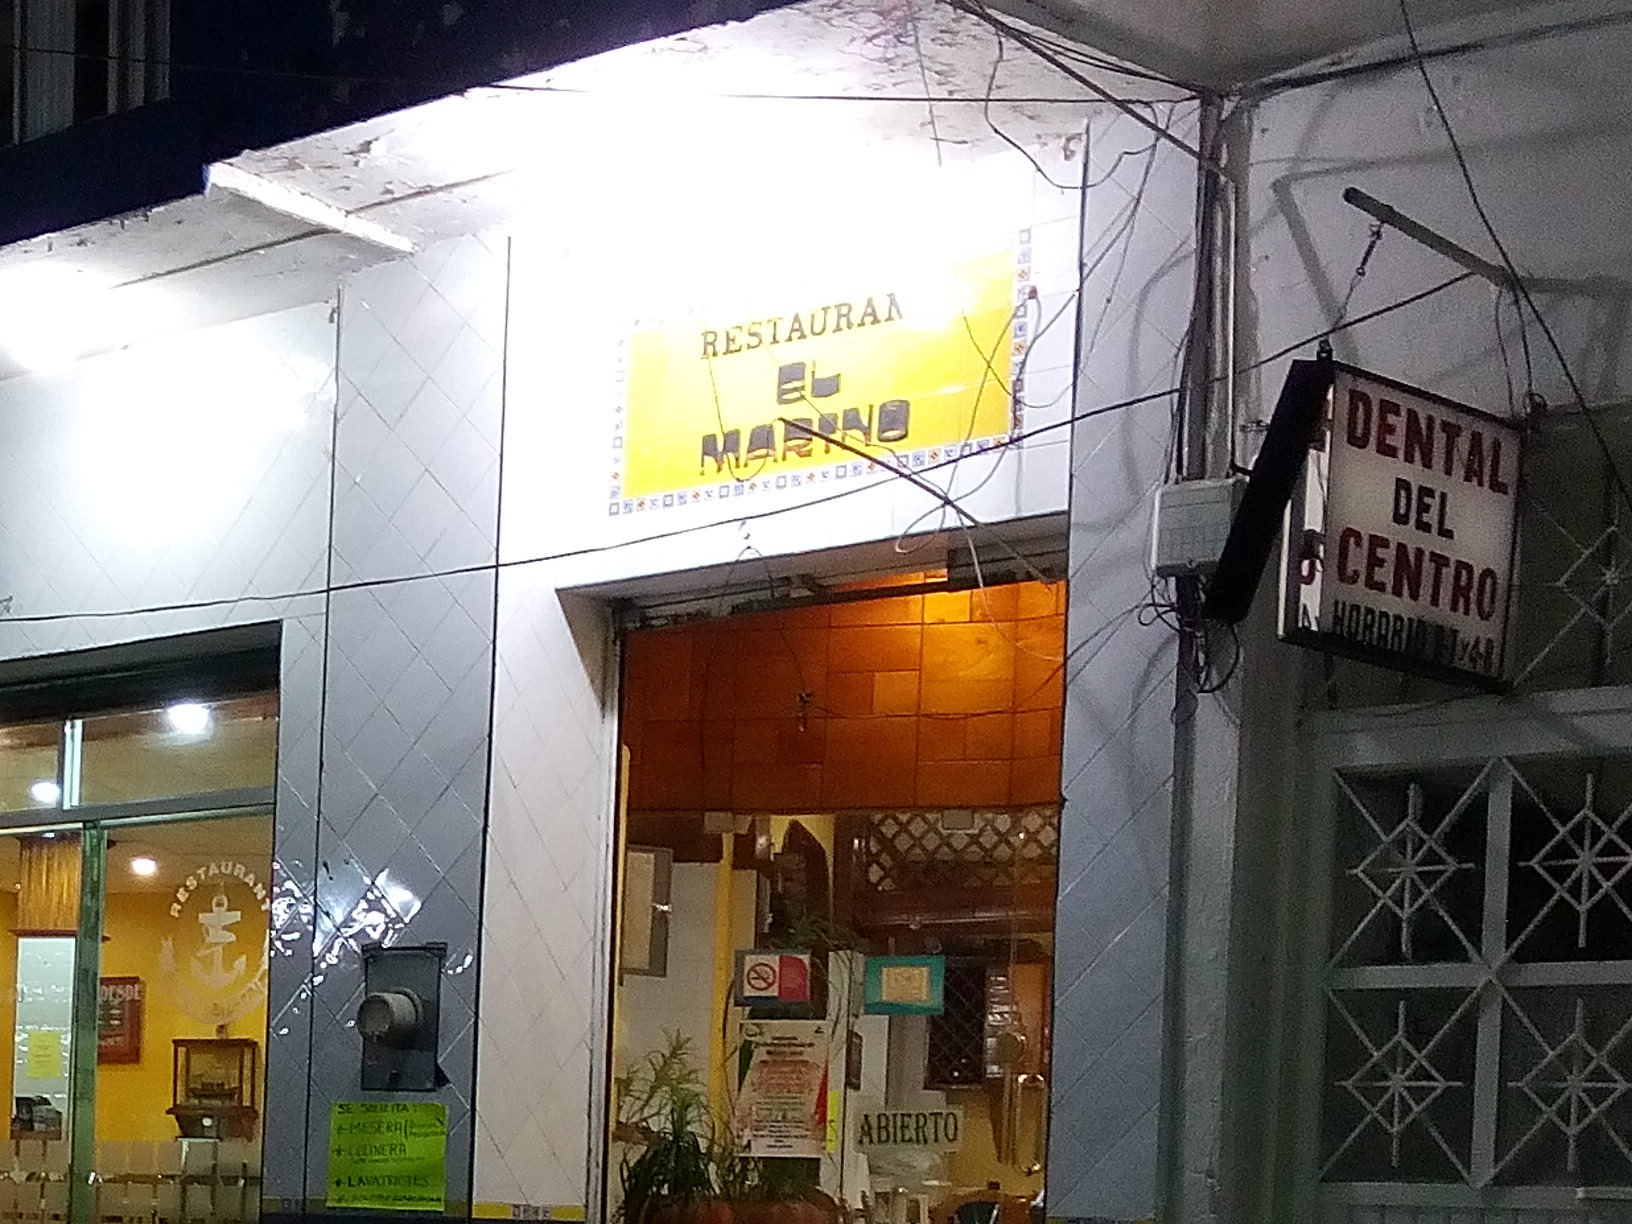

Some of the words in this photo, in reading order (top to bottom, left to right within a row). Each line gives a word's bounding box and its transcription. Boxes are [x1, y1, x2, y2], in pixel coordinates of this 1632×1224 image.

[777, 360, 841, 405] EL
[1346, 388, 1510, 496] DENTAL
[1392, 477, 1455, 541] DEL
[1336, 527, 1498, 622] CENTRO
[858, 1111, 959, 1146] ABIERTO
